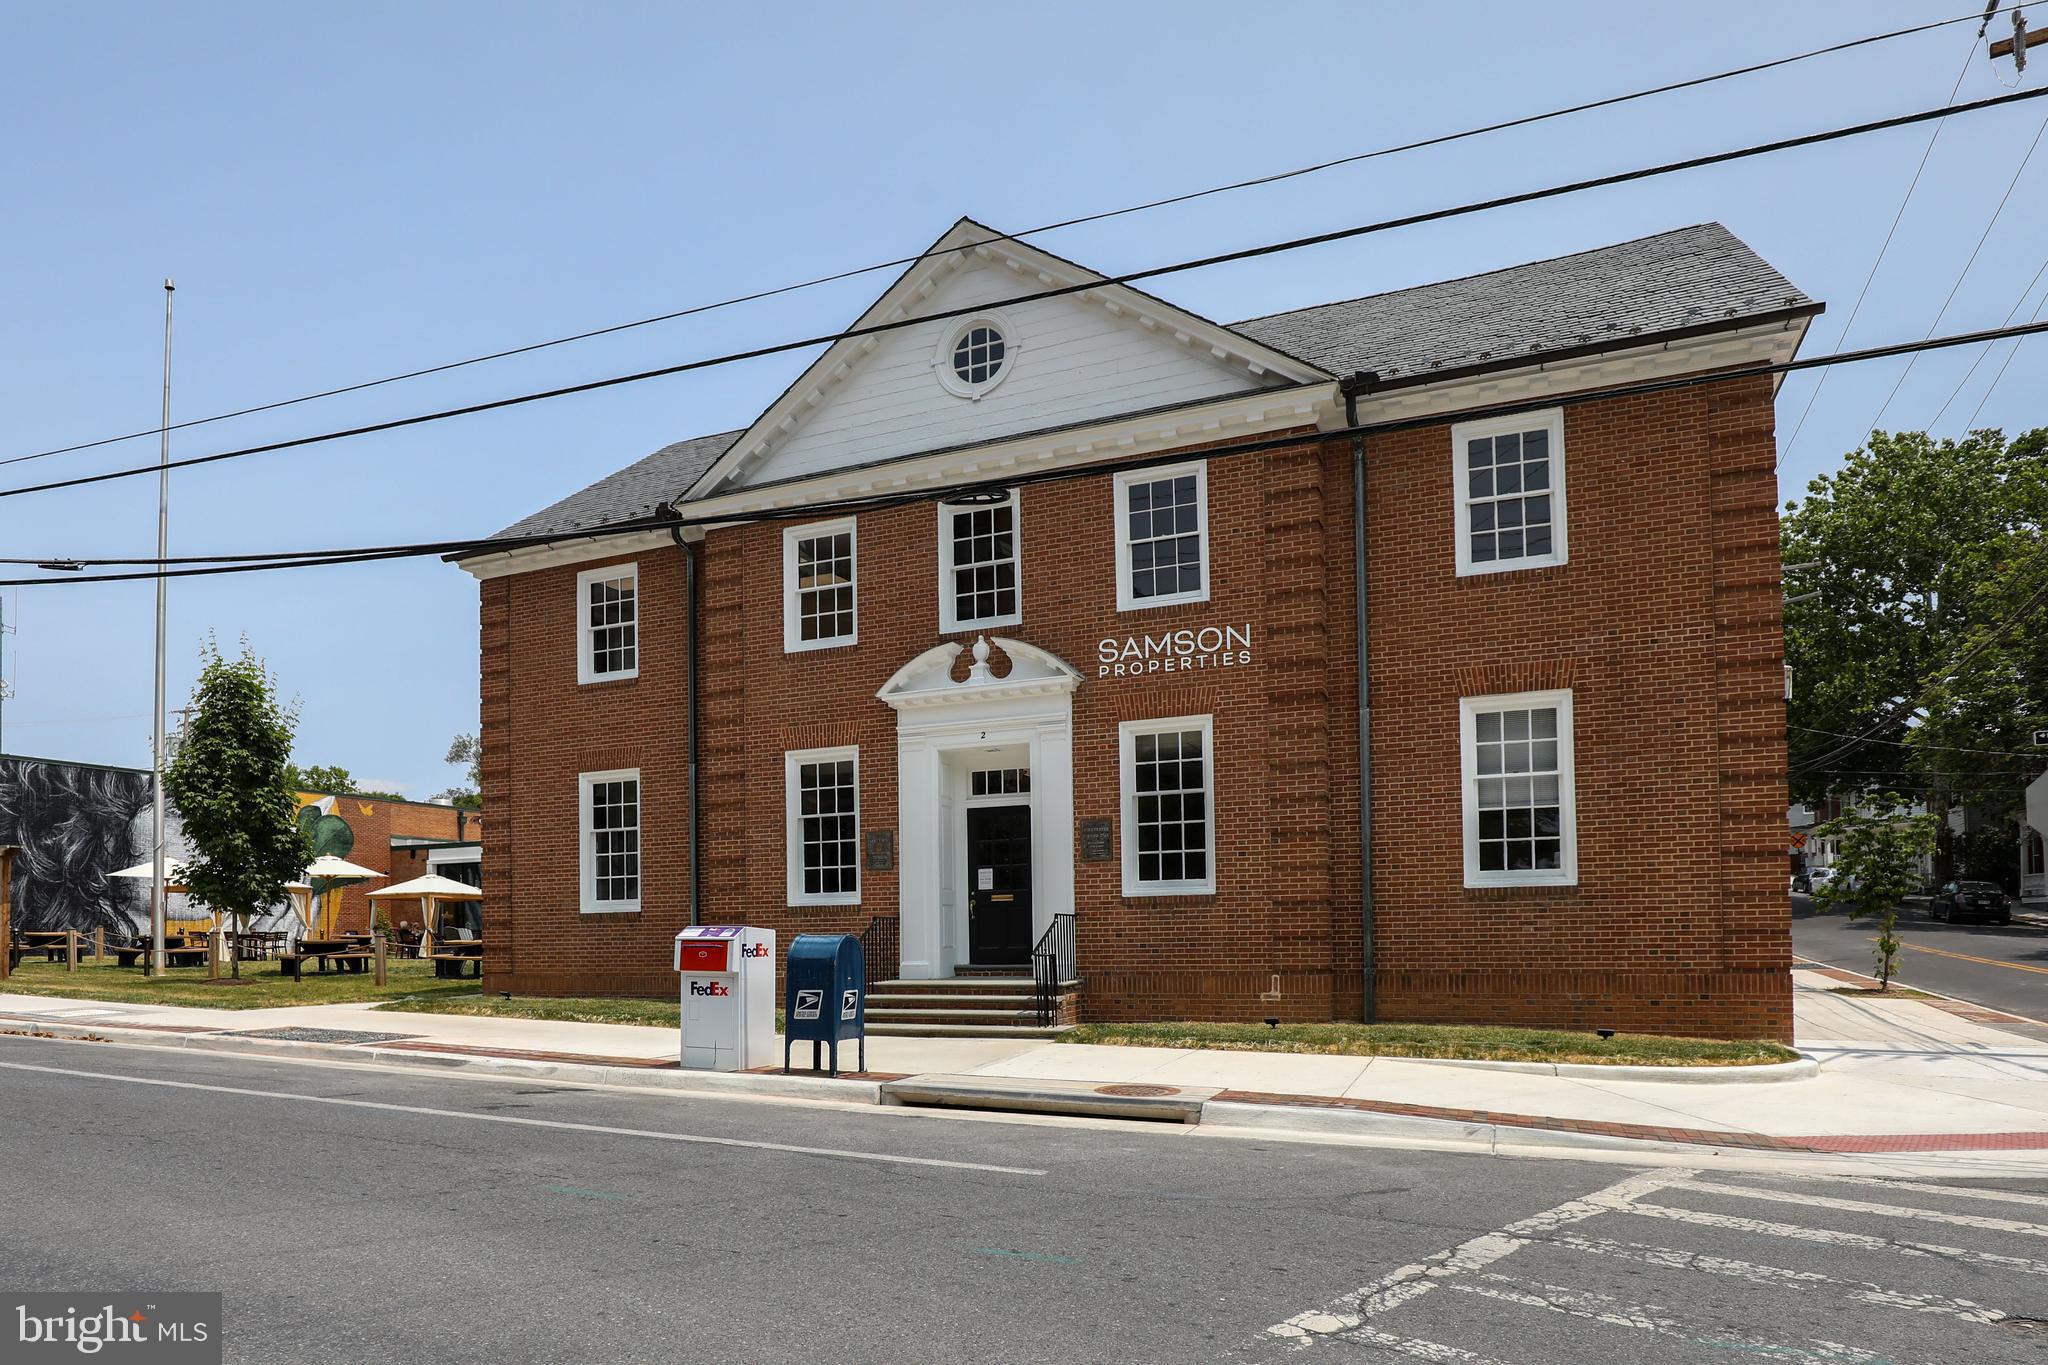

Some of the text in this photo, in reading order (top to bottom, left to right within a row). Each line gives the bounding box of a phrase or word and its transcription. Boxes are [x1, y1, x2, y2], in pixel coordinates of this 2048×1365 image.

[1098, 623, 1251, 663] SAMSON
[1098, 650, 1251, 679] PROPERTIES
[980, 731, 986, 740] 2
[741, 943, 769, 958] FedEx
[690, 981, 729, 996] FedEx
